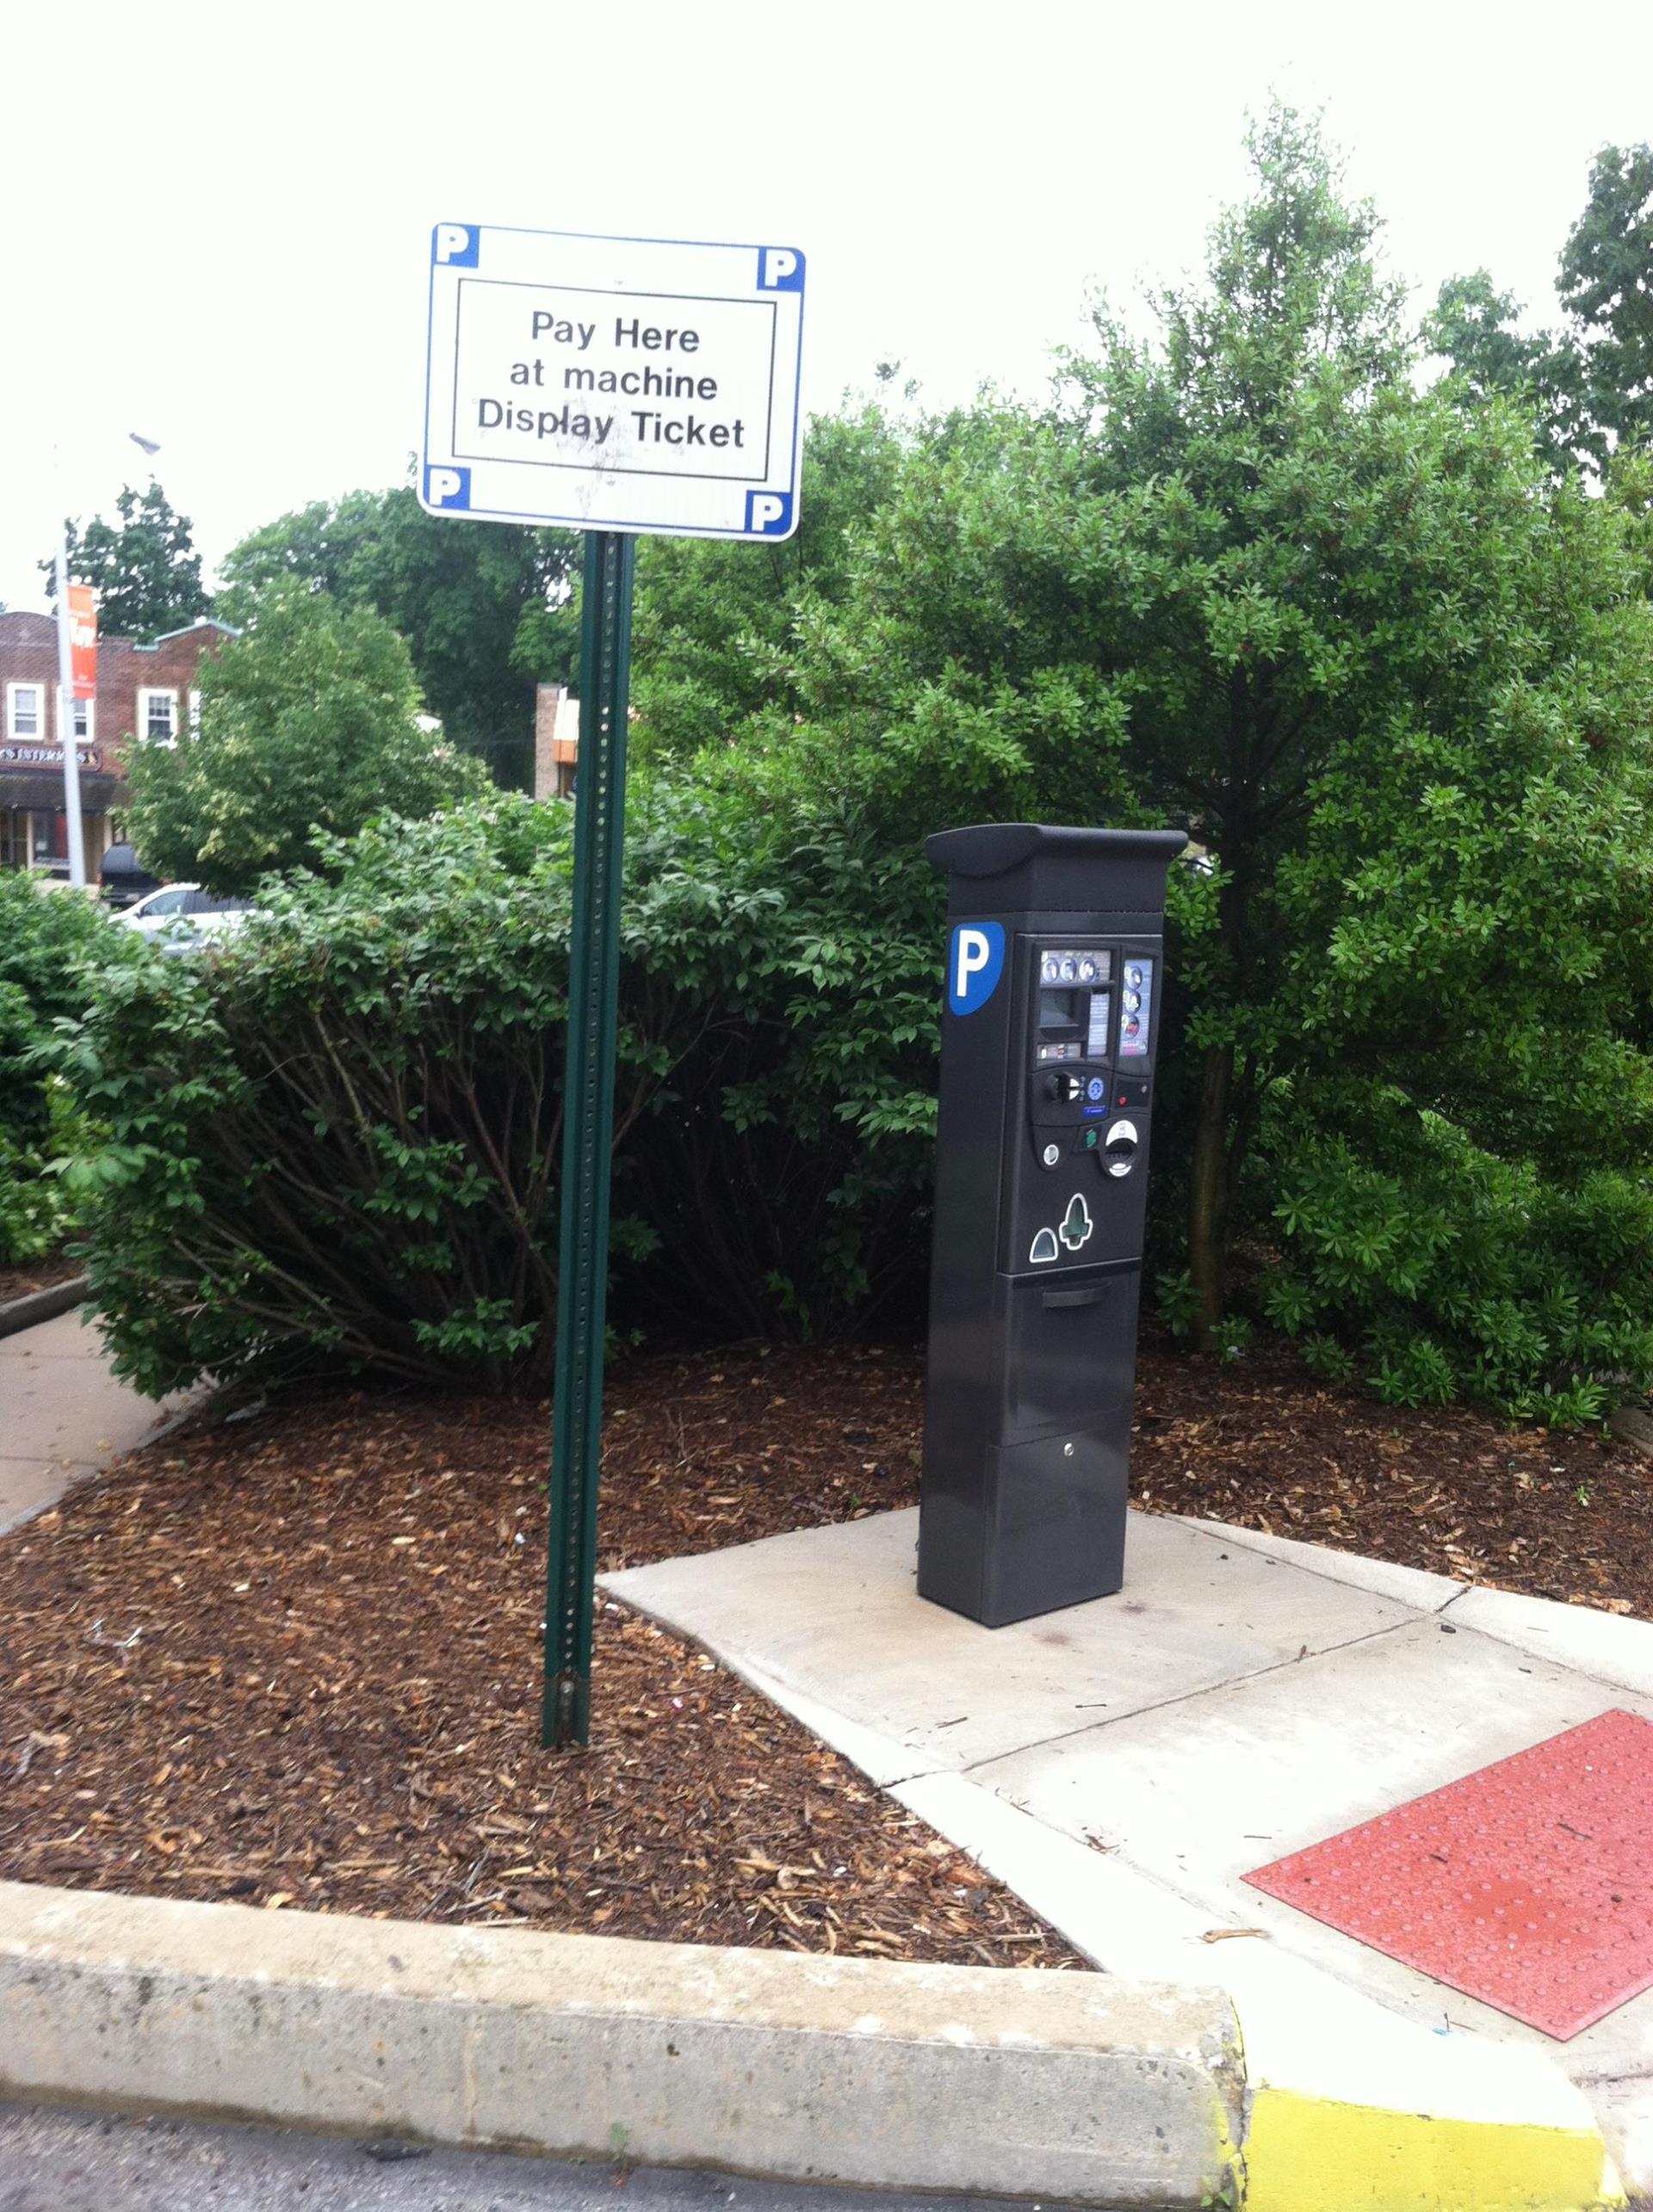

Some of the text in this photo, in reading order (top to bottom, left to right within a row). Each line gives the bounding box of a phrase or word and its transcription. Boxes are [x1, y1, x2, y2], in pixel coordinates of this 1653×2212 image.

[436, 225, 469, 263] P
[765, 250, 797, 287] P
[531, 311, 700, 353] Pay Here
[510, 359, 718, 400] at machine
[477, 398, 745, 448] Display Ticket
[429, 468, 461, 506] P
[752, 495, 783, 532] P
[957, 929, 990, 998] P
